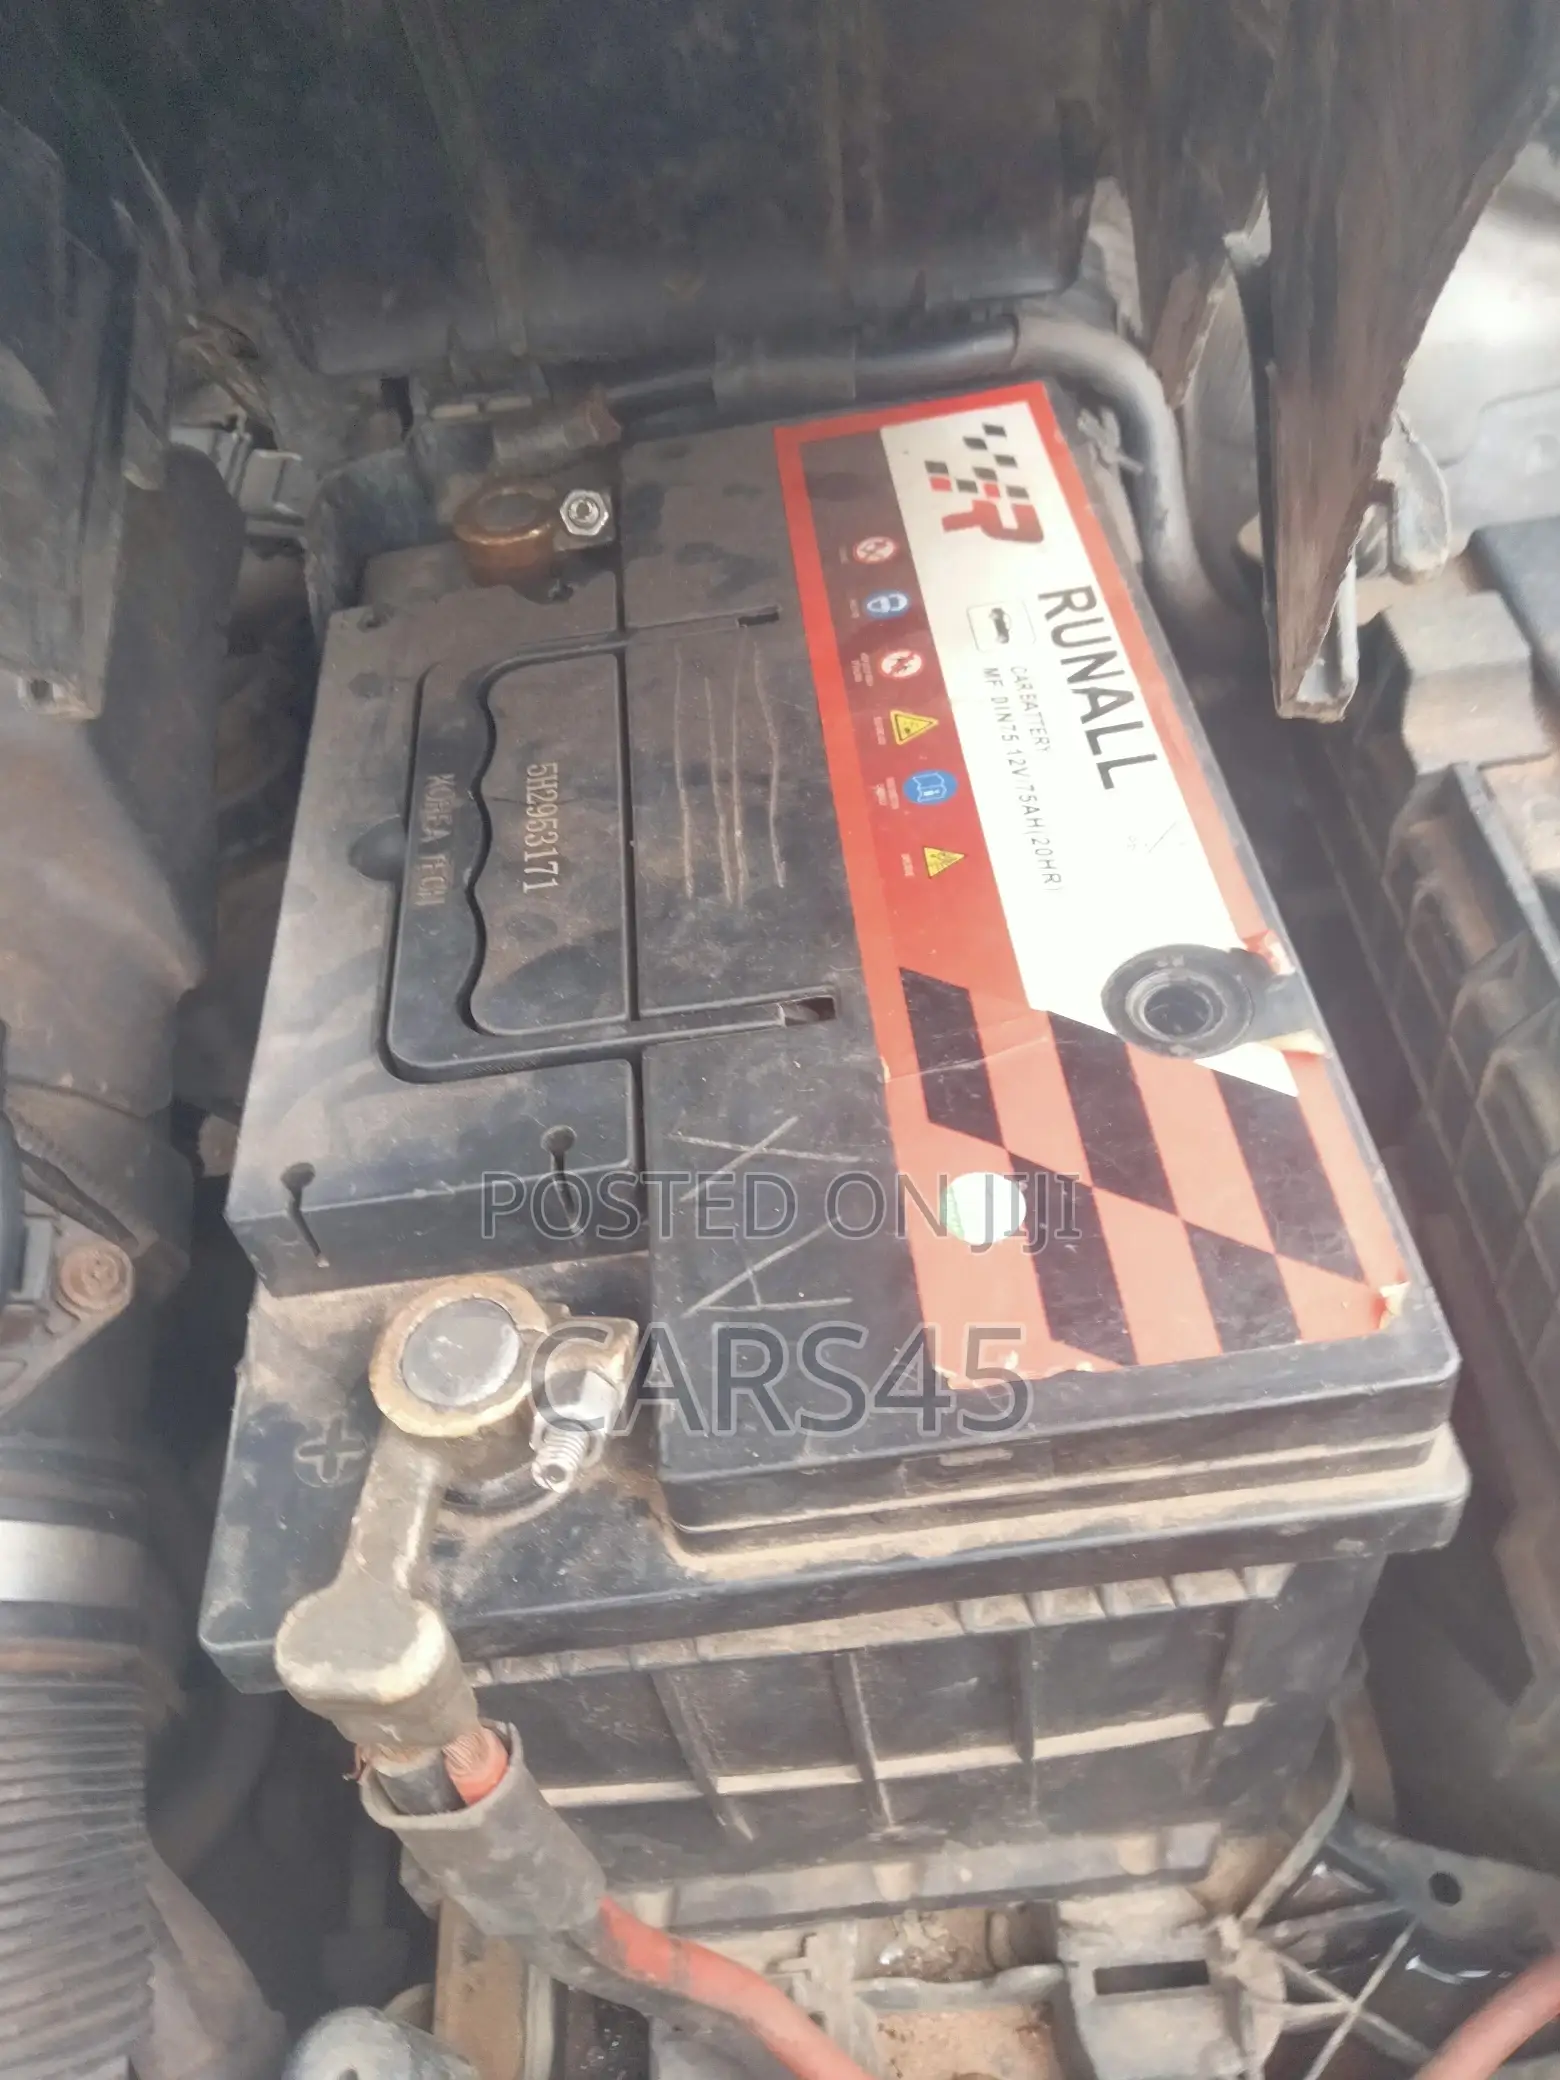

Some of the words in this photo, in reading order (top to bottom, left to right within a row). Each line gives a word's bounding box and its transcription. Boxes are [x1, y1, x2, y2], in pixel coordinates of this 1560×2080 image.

[983, 667, 1004, 687] MF
[991, 696, 1020, 742] DIN75
[1038, 585, 1158, 790] RUNALL
[522, 761, 560, 894] 5H2953171
